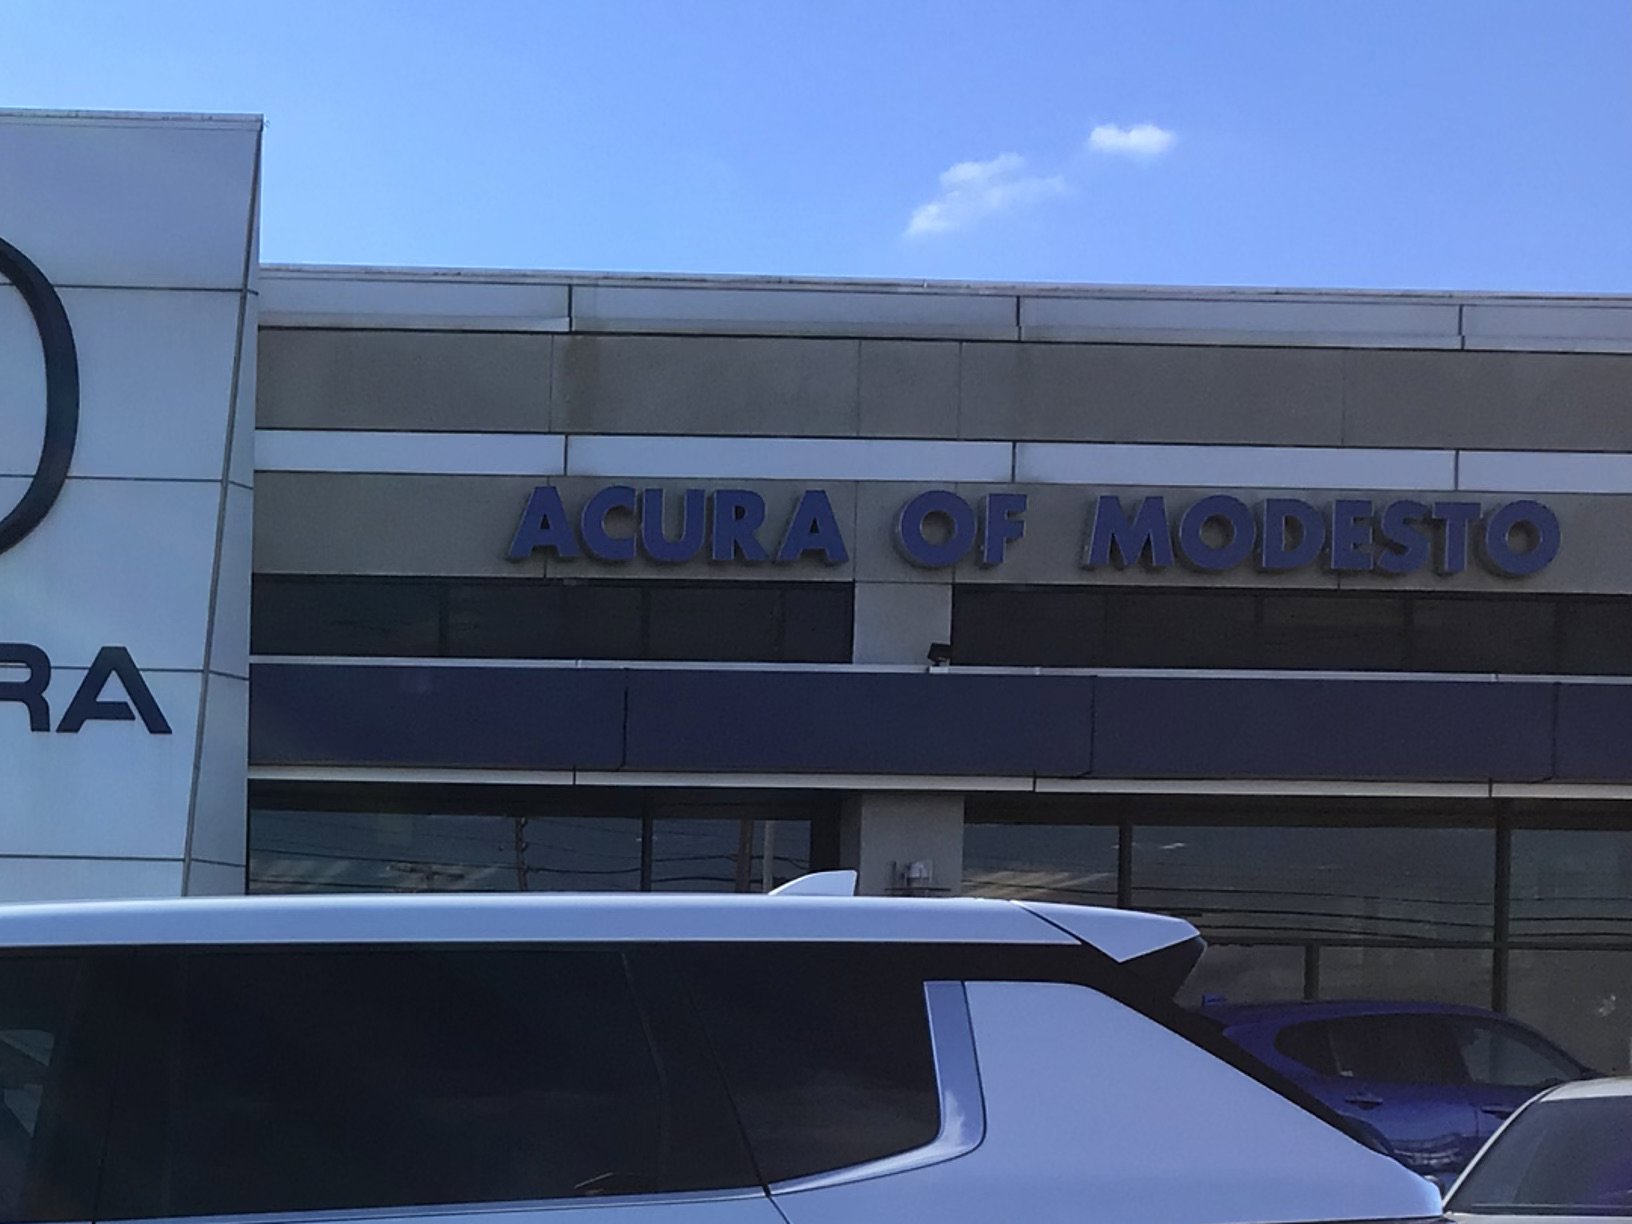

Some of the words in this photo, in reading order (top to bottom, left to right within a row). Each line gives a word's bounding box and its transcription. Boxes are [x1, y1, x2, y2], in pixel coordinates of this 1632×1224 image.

[505, 485, 849, 564] ACURA
[894, 490, 1027, 569] OF
[1083, 494, 1562, 576] MODESTO
